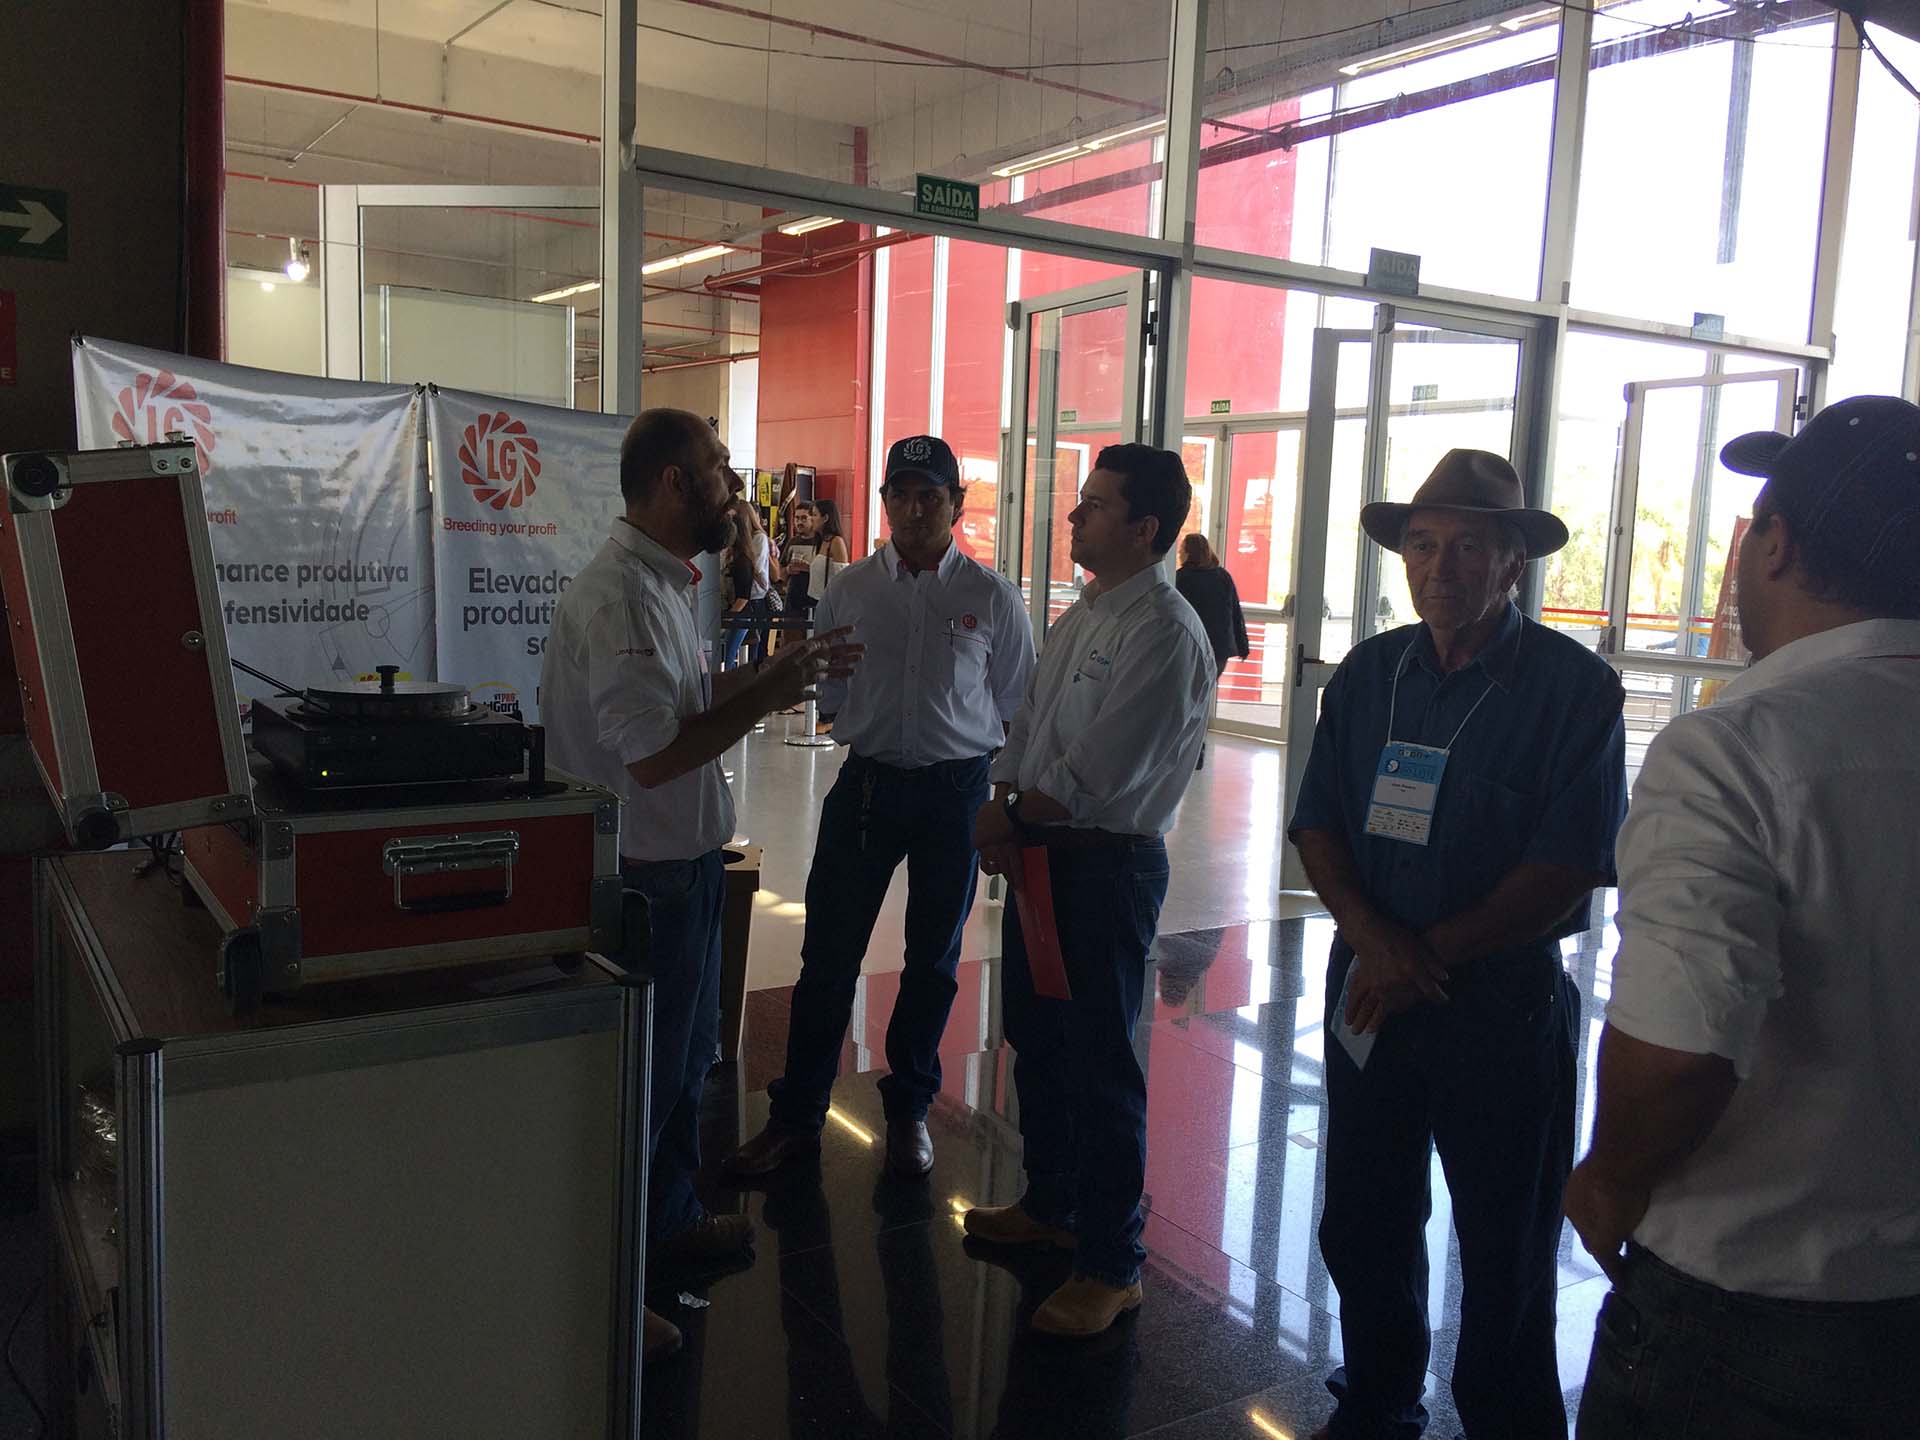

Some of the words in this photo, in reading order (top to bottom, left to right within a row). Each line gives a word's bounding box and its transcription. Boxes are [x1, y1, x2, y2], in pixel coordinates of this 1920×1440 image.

[922, 183, 974, 210] SAÍDA
[486, 438, 517, 482] LG
[208, 508, 237, 524] rofit
[443, 517, 497, 535] Breeding
[499, 524, 526, 537] your
[528, 522, 557, 537] profit
[216, 562, 289, 583] ance
[297, 556, 408, 589] produtiva
[224, 597, 370, 625] fensividade
[463, 601, 555, 632] produti
